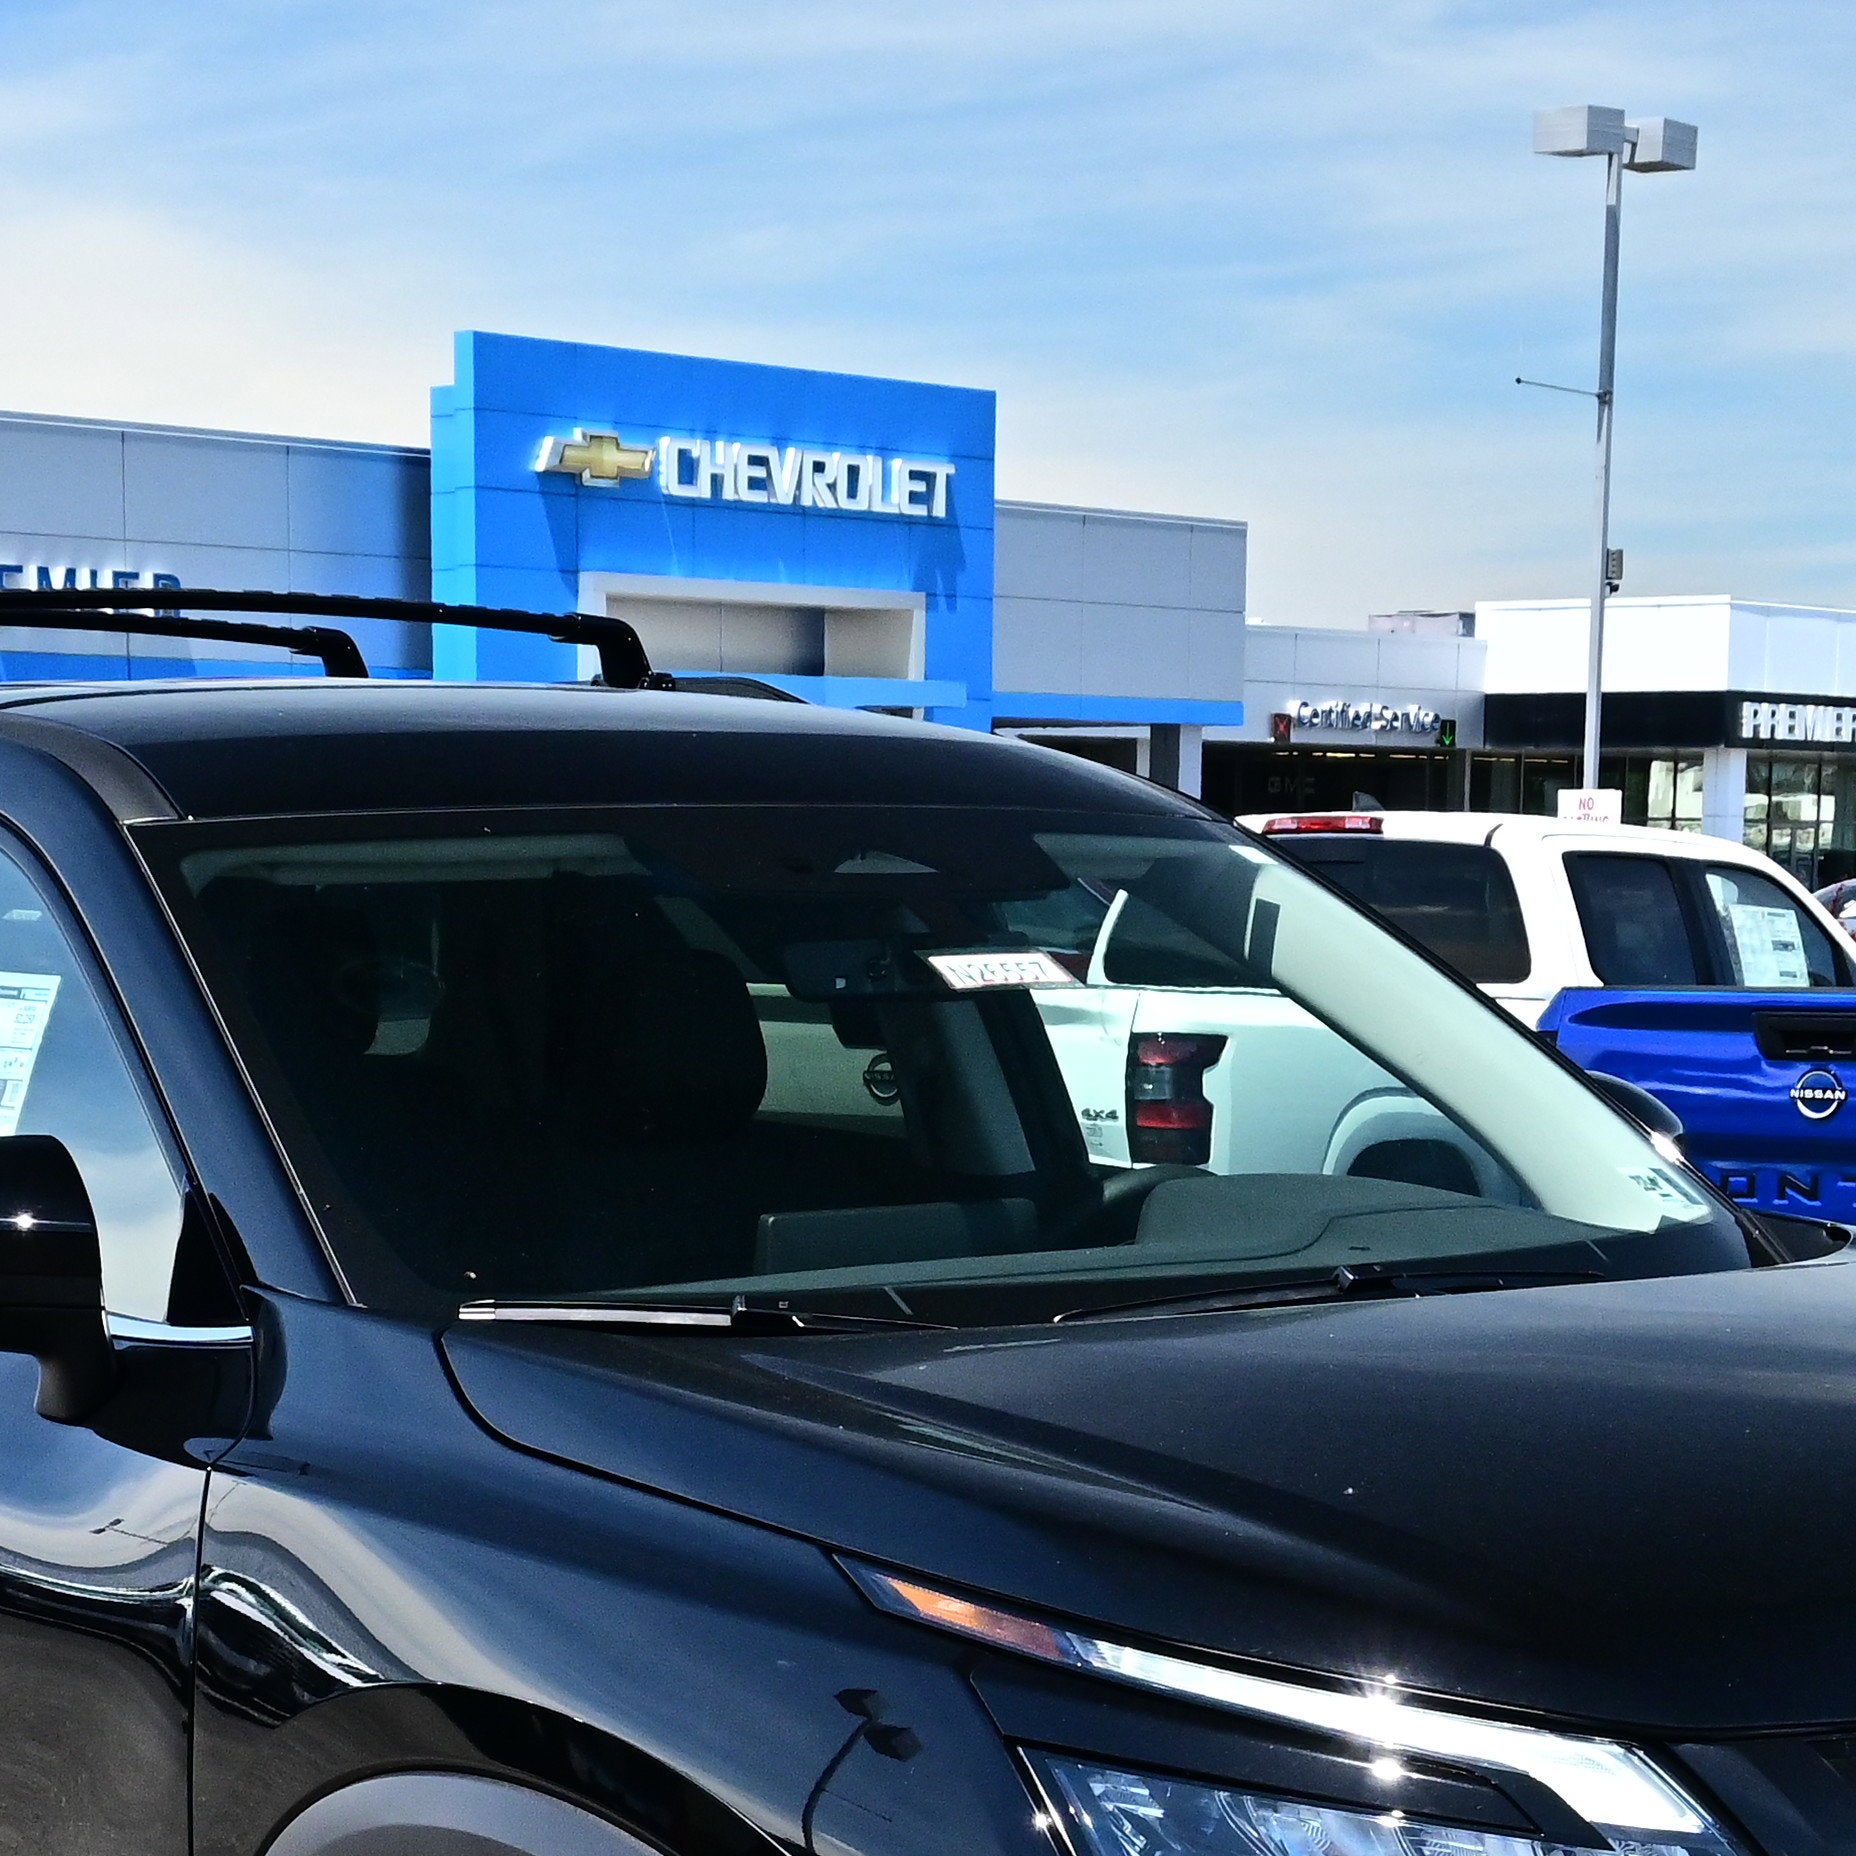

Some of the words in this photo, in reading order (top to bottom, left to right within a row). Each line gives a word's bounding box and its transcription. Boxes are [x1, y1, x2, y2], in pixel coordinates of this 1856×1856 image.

[658, 435, 956, 519] CHEVROLET
[1297, 701, 1373, 729] Certified
[1379, 705, 1442, 732] Service
[1578, 797, 1595, 810] NO
[1790, 1088, 1846, 1101] NISSAN
